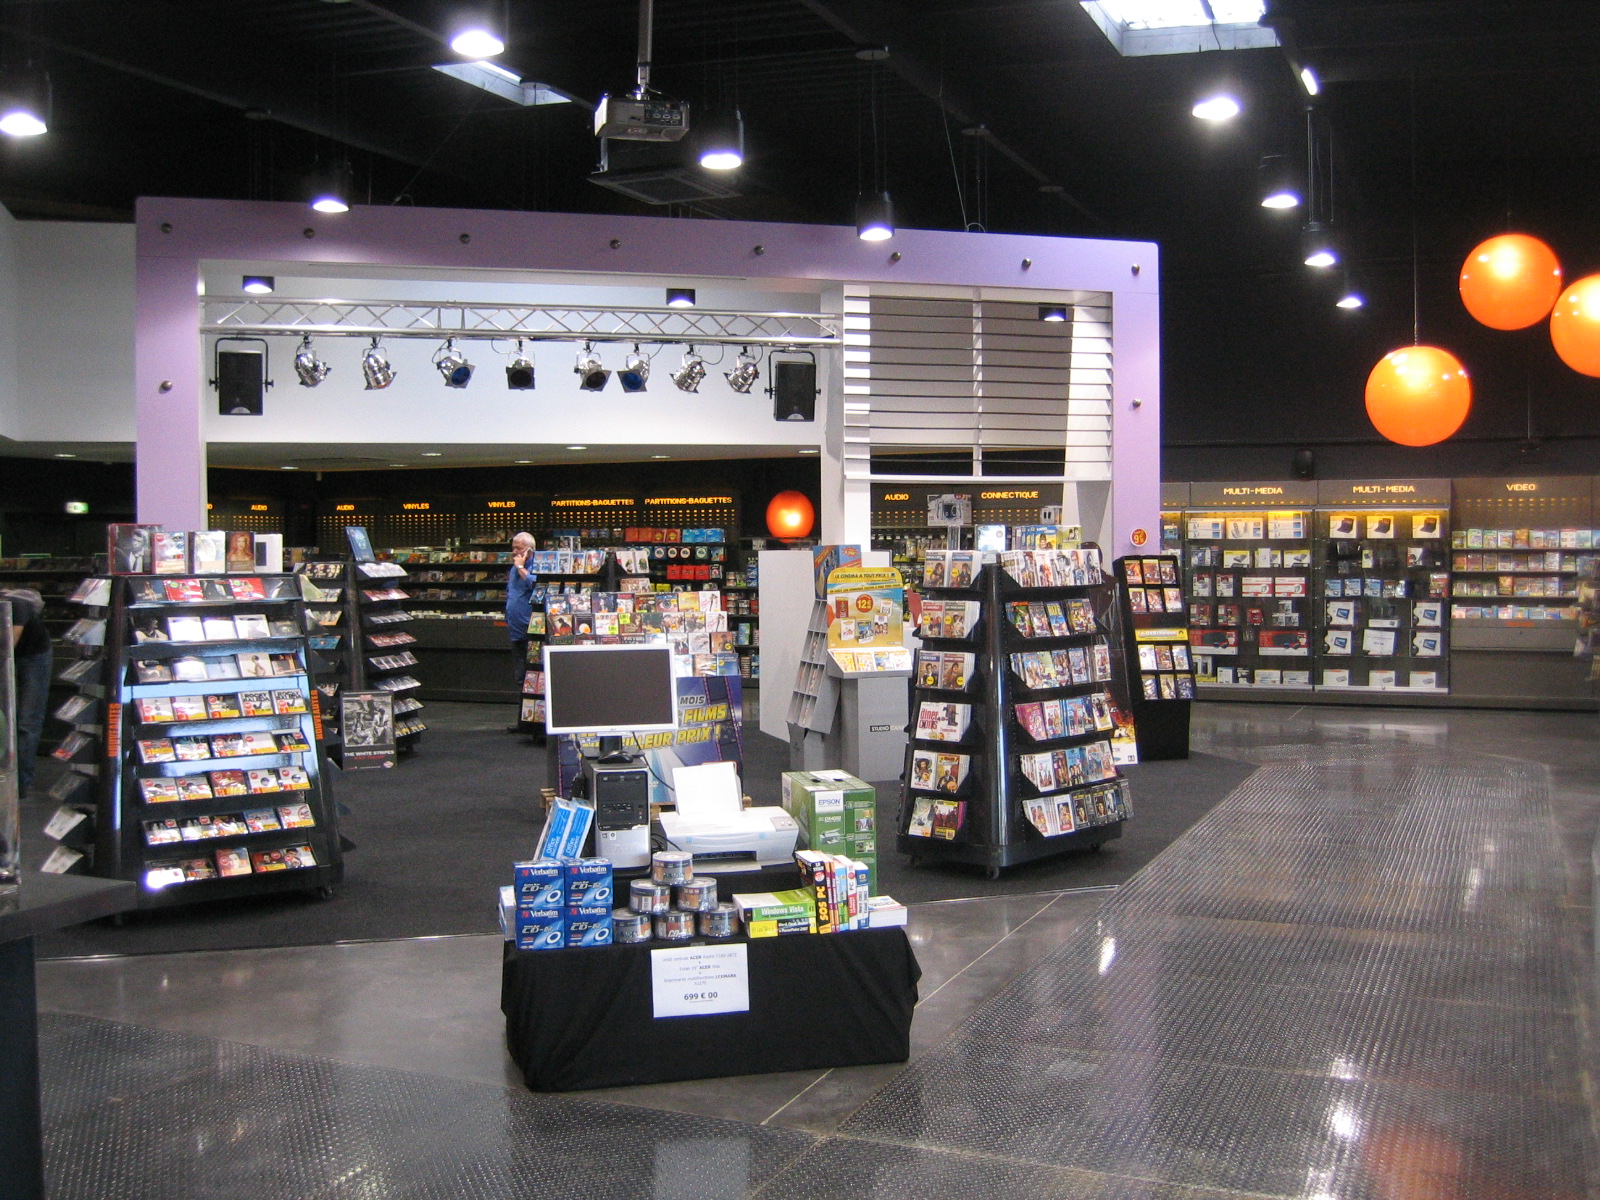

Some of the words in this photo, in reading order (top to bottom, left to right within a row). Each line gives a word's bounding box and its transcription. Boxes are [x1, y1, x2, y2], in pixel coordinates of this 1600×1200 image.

[1506, 483, 1536, 491] VIDEO
[884, 493, 910, 501] AUDIO
[981, 491, 1039, 500] CONNECTIQUE
[551, 499, 635, 507] PARTITIONS-BAGUETTES
[644, 496, 733, 506] PARTITIONS-BAGUETTES
[680, 696, 705, 705] MOIS
[684, 704, 727, 724] FILMS
[676, 726, 712, 745] PRIX
[818, 798, 841, 806] EPSON
[546, 837, 556, 854] Office
[565, 837, 576, 854] Office
[530, 868, 558, 876] Verbatim
[579, 866, 607, 874] Verbatim
[816, 886, 827, 899] PC
[530, 910, 558, 918] Verbatim
[579, 907, 607, 915] Verbatim
[762, 907, 788, 916] Windows
[790, 905, 805, 914] Vista
[818, 901, 829, 921] SOS
[684, 992, 699, 1001] 699
[708, 991, 718, 999] 00
